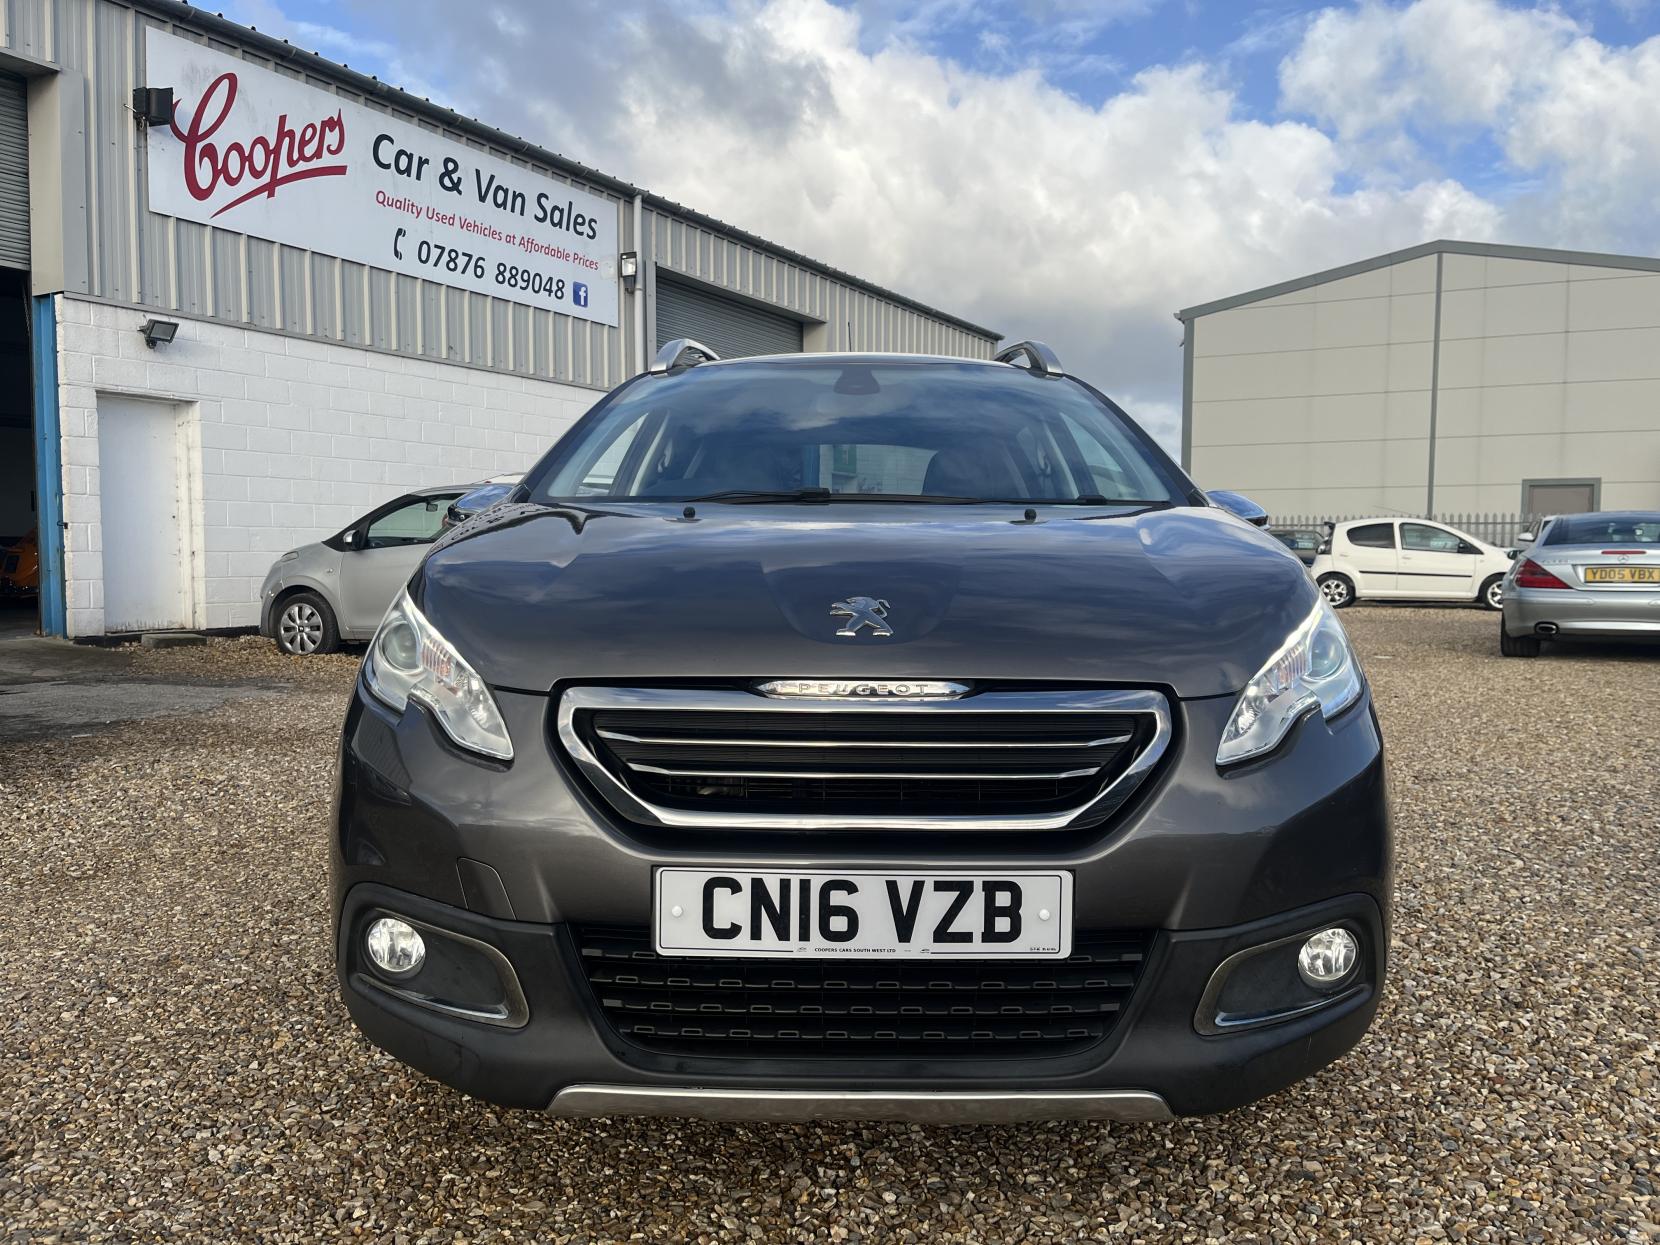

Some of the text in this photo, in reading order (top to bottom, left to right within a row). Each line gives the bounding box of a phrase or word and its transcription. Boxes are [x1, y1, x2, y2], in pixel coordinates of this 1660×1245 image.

[169, 72, 345, 201] Coopers
[372, 133, 598, 240] Car & Van Sales
[375, 190, 599, 271] Quality Used Vehicles at Affordable Prices
[417, 240, 566, 300] 07876 889048
[1591, 568, 1655, 581] YD05 VBX
[798, 683, 929, 696] PEUGEOT
[702, 876, 1023, 944] CN16 VZB
